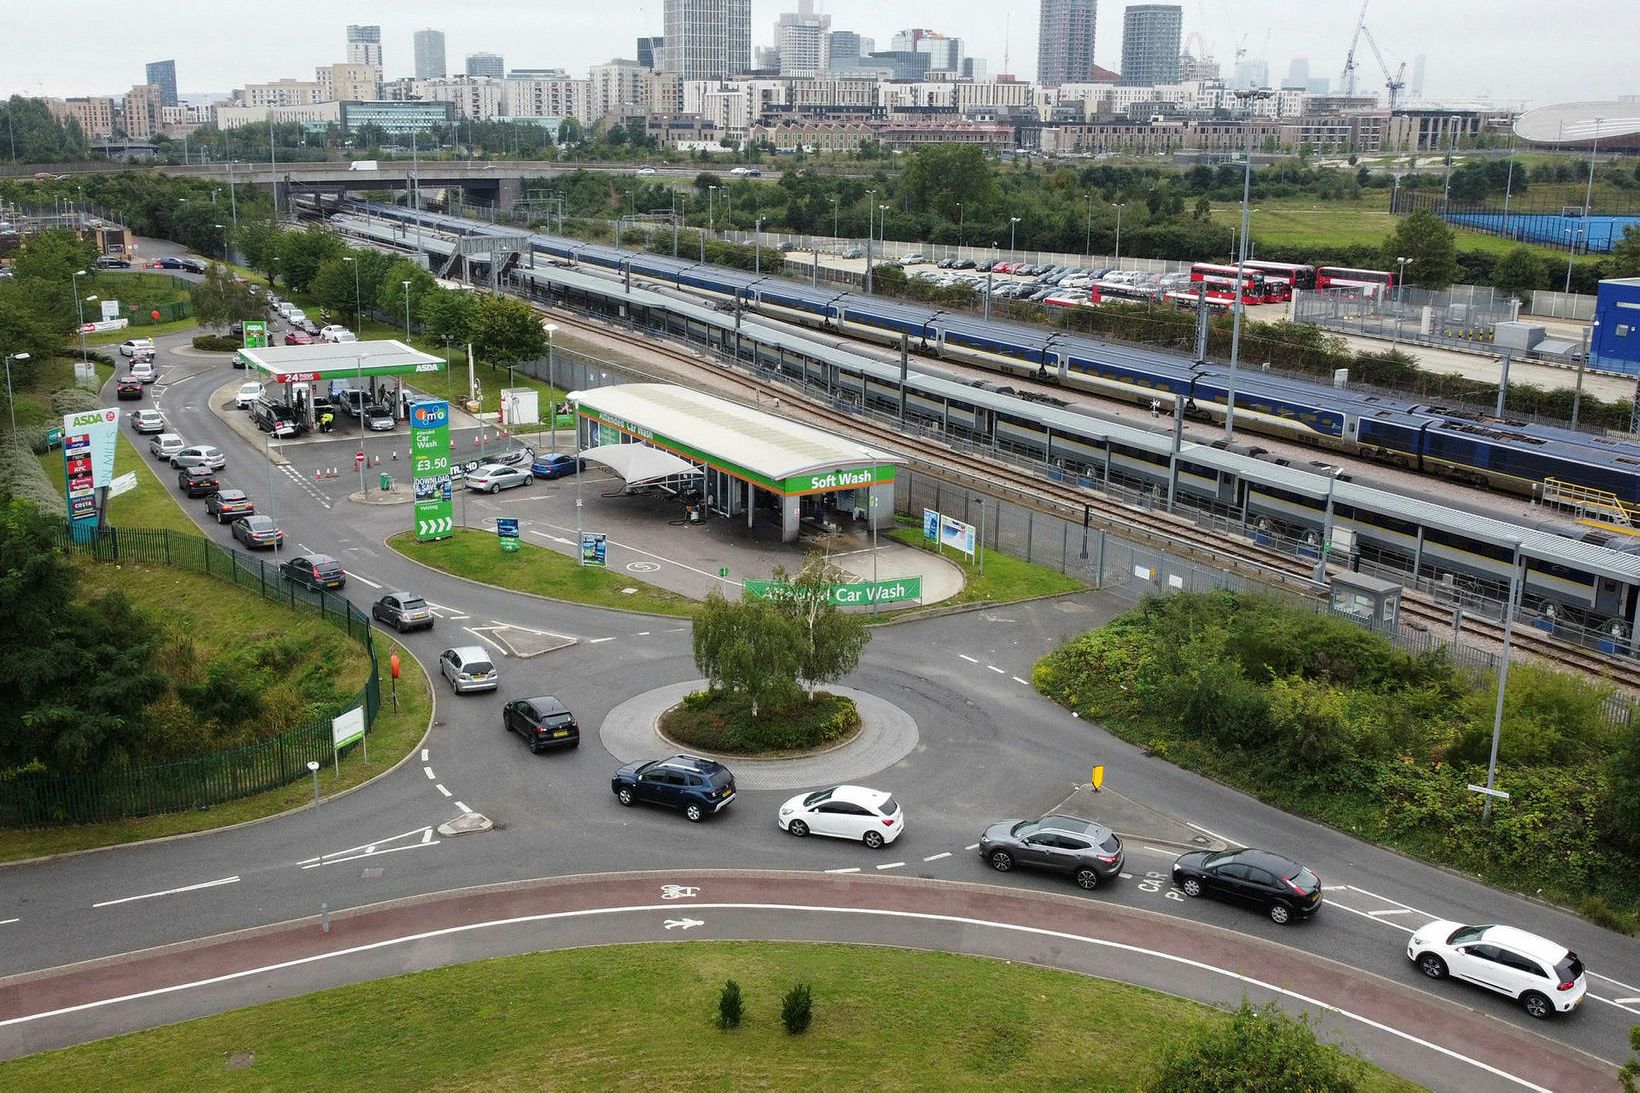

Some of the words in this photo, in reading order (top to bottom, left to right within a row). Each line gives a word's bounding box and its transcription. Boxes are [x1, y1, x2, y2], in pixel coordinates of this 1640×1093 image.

[416, 364, 438, 372] ASDA
[285, 373, 299, 382] 24
[73, 414, 103, 427] ASDA
[626, 422, 637, 432] Car
[417, 440, 438, 449] Wash
[417, 457, 447, 470] £3.50
[811, 474, 836, 489] Soft
[838, 470, 872, 485] Wash
[835, 588, 863, 602] Car
[866, 583, 905, 601] Wash
[1137, 871, 1169, 892] CAR
